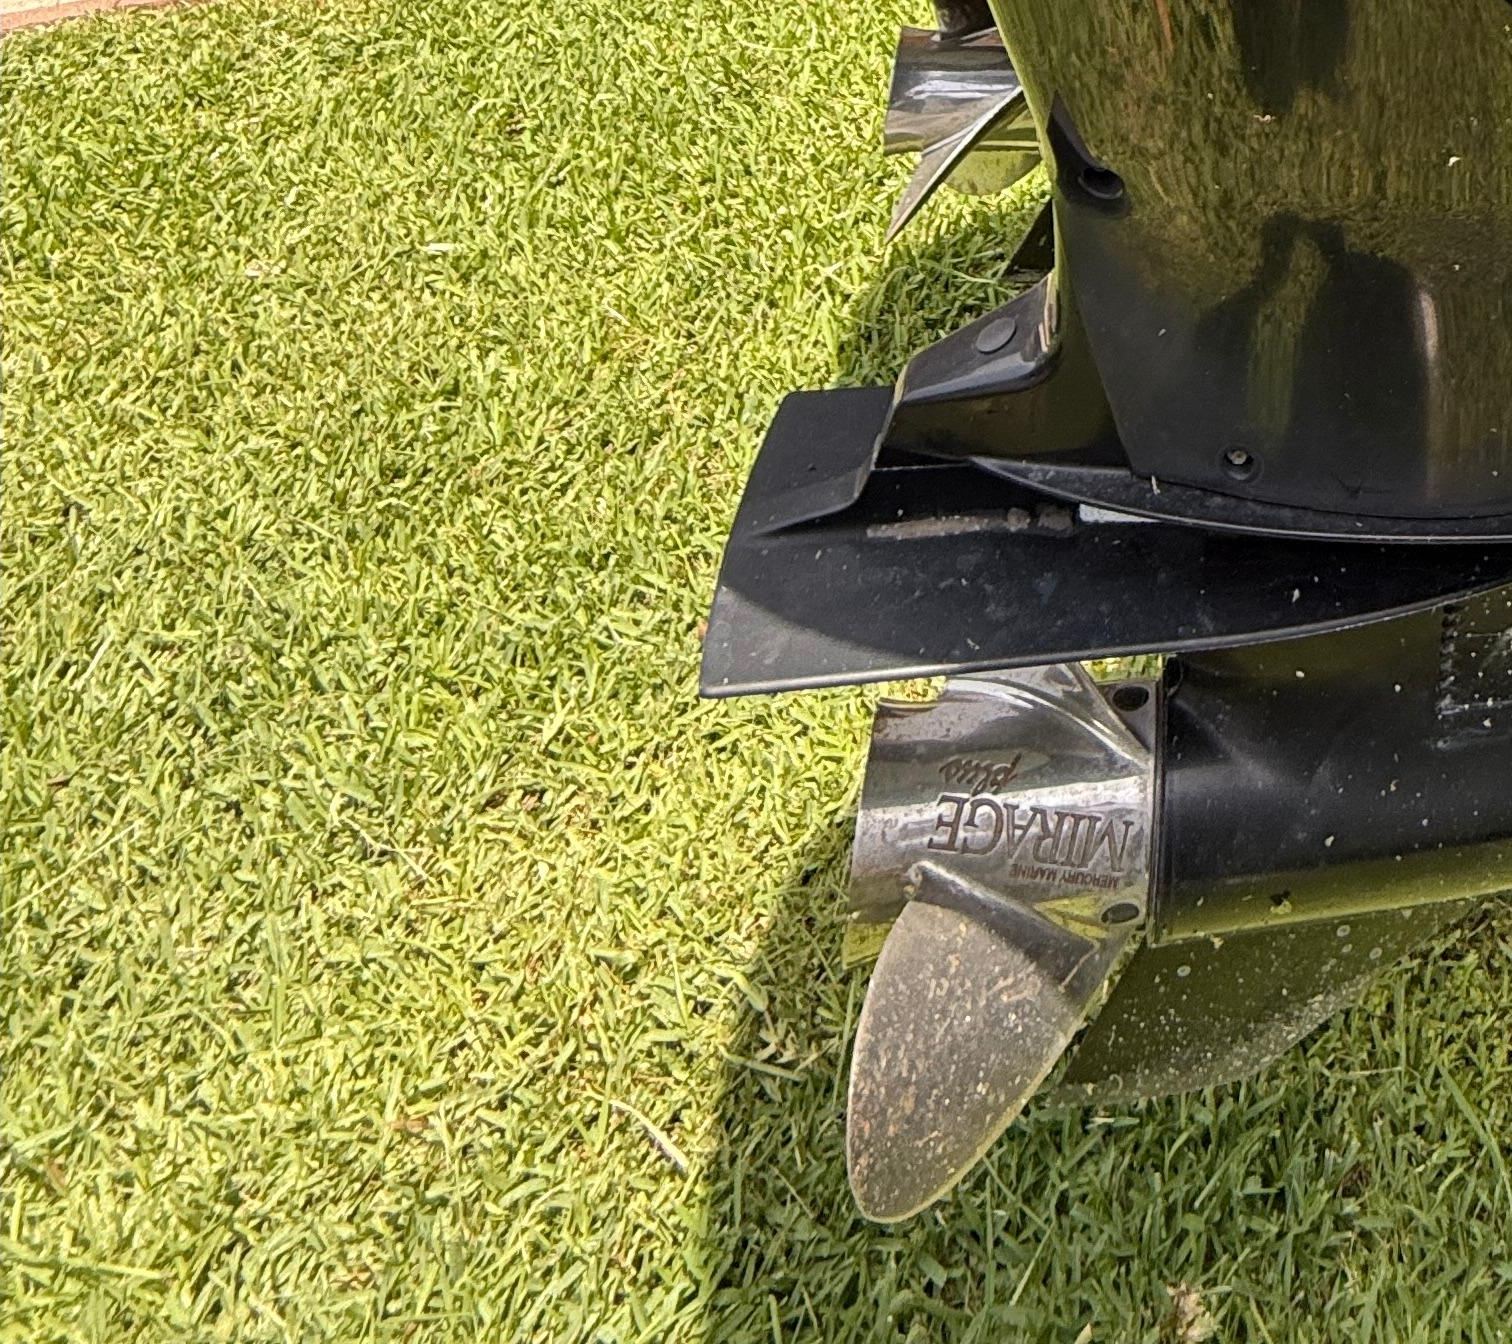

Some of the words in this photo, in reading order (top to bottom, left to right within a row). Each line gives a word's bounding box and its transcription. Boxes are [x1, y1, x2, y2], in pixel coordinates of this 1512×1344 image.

[939, 752, 1023, 797] plus
[926, 794, 1135, 874] MIRAGE
[1007, 863, 1057, 883] MARINE
[1061, 869, 1120, 889] MERCURY
